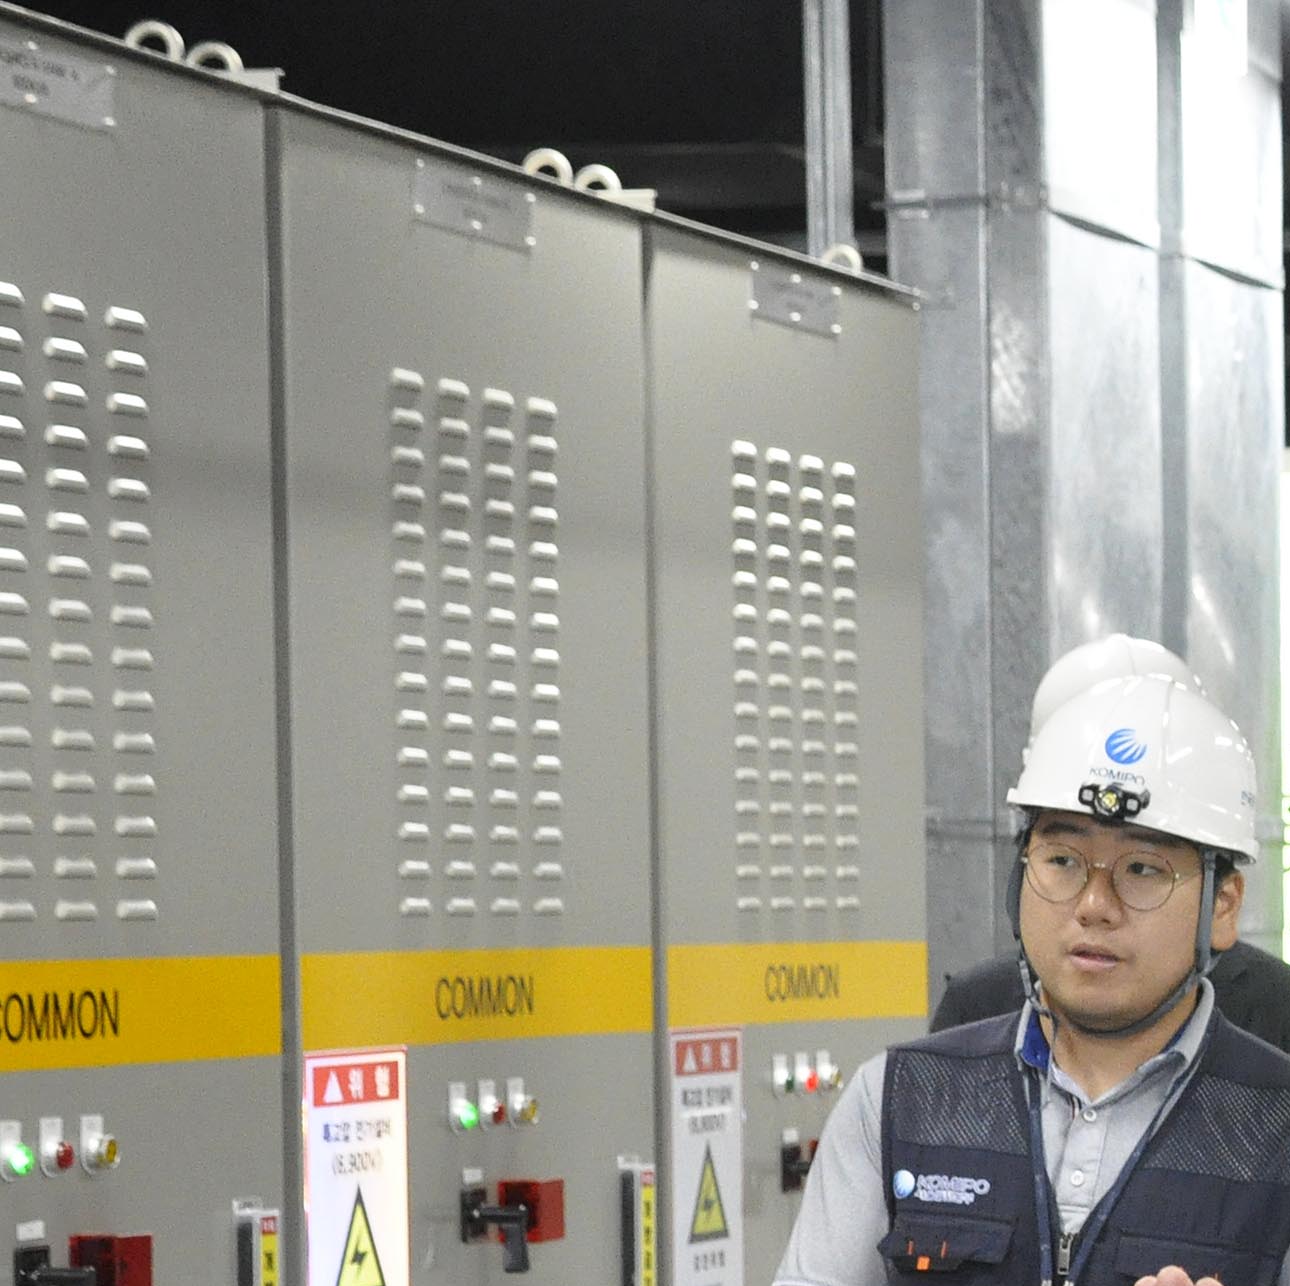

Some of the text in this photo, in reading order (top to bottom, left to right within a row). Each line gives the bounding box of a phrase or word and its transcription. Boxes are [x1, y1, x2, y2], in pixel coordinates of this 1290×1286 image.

[435, 975, 535, 1020] COMMON
[764, 964, 840, 1002] COMMON
[0, 989, 119, 1042] OMMON
